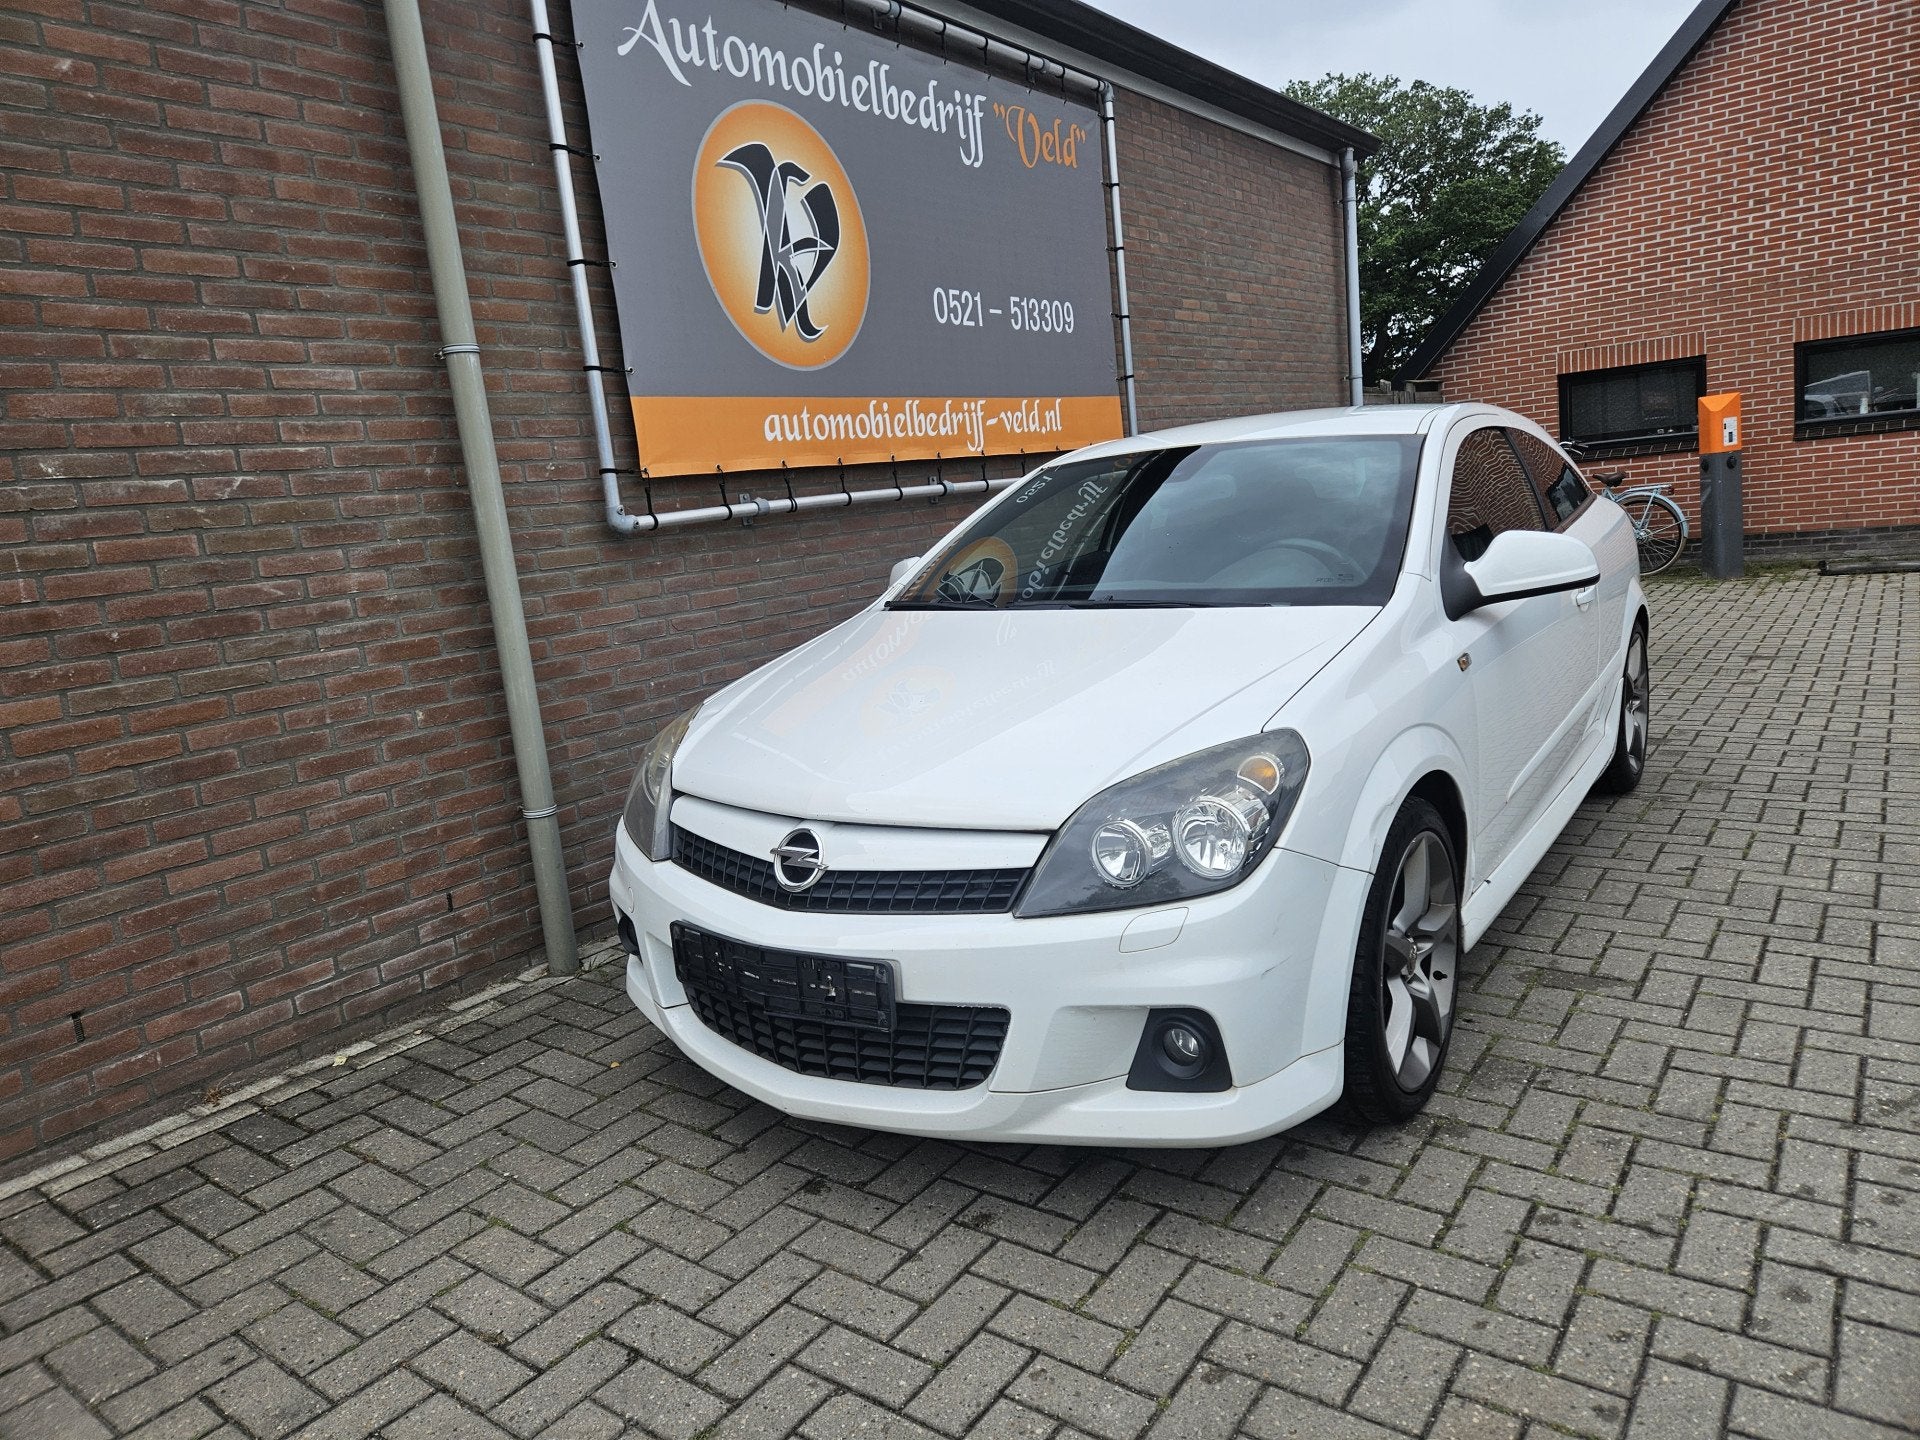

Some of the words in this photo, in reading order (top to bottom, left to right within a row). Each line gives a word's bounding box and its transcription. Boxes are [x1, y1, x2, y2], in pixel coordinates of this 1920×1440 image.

[617, 0, 986, 168] Automobielbedrijf
[933, 287, 983, 327] 0521
[1010, 296, 1075, 333] 513309
[764, 398, 1063, 452] automobielbedrijf-veld.nl
